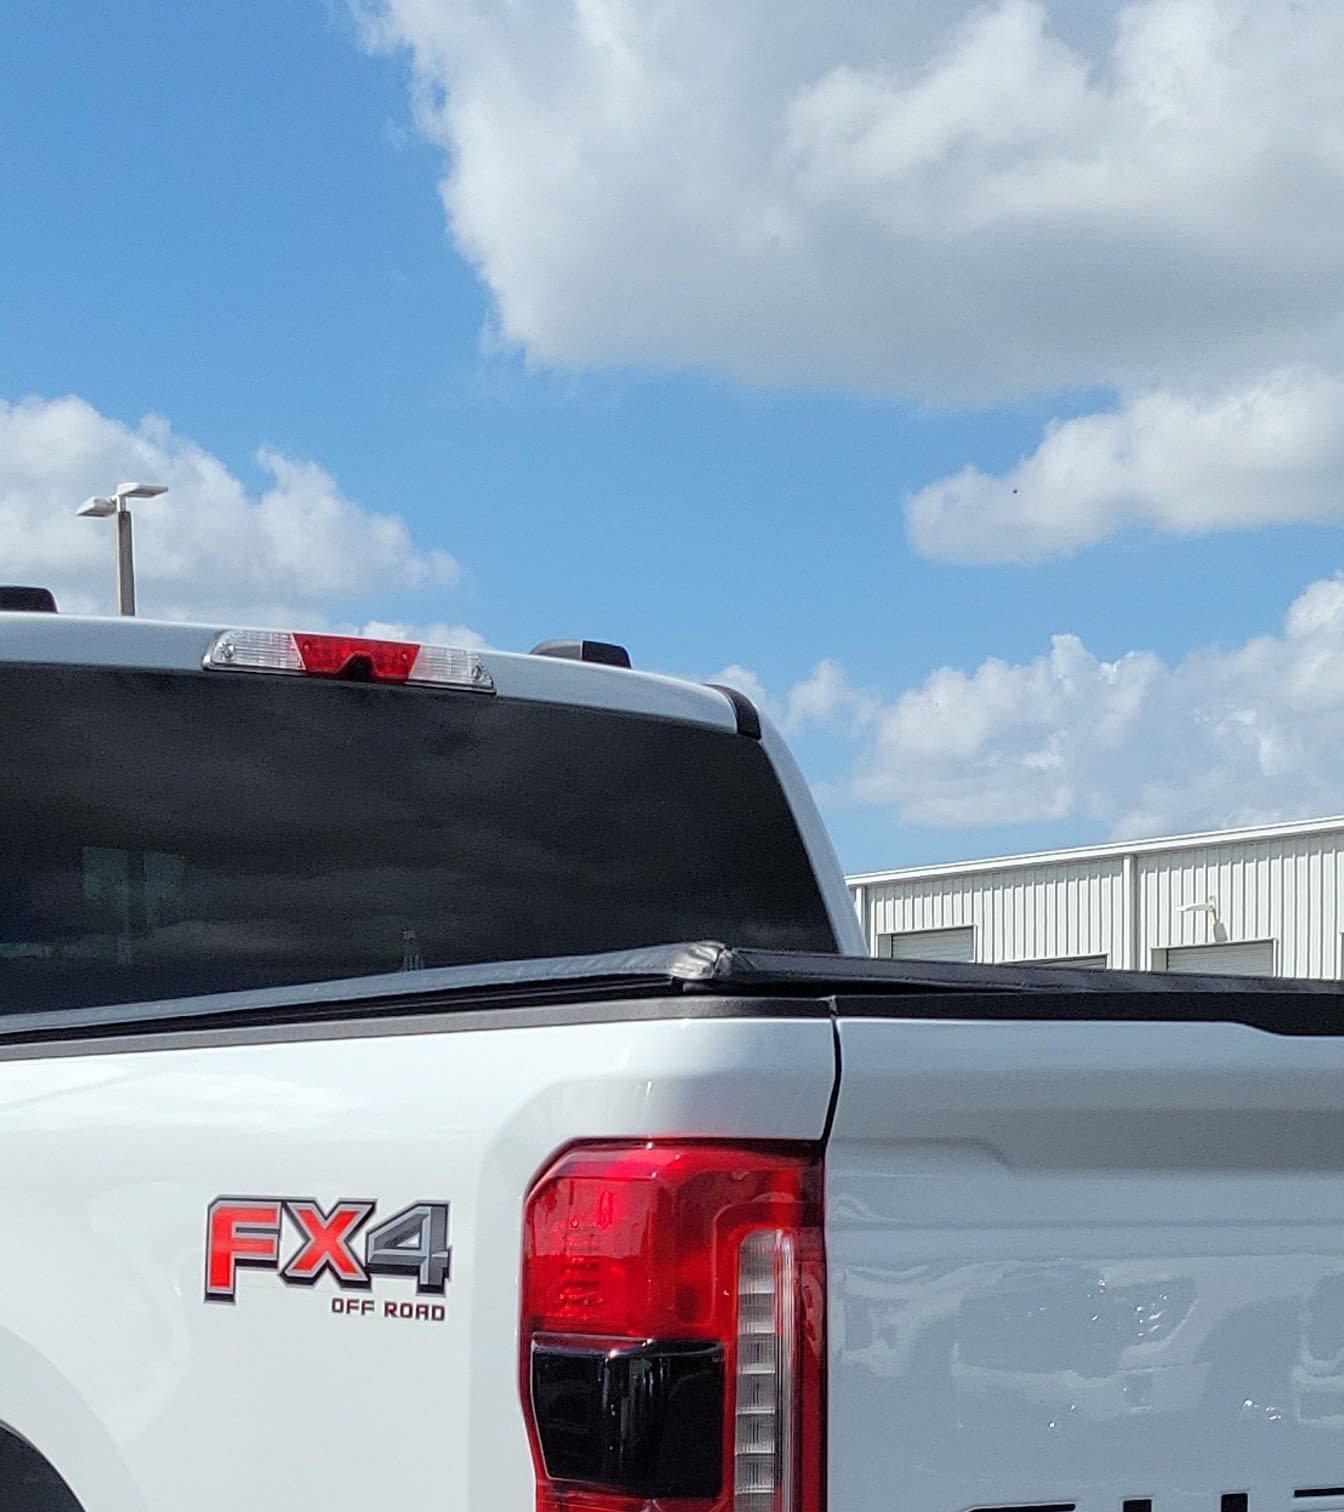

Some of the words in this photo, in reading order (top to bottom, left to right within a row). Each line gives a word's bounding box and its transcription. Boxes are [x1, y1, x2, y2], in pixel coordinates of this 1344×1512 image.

[204, 1195, 452, 1304] FX4
[331, 1297, 375, 1316] OFF
[384, 1301, 446, 1322] ROAD
